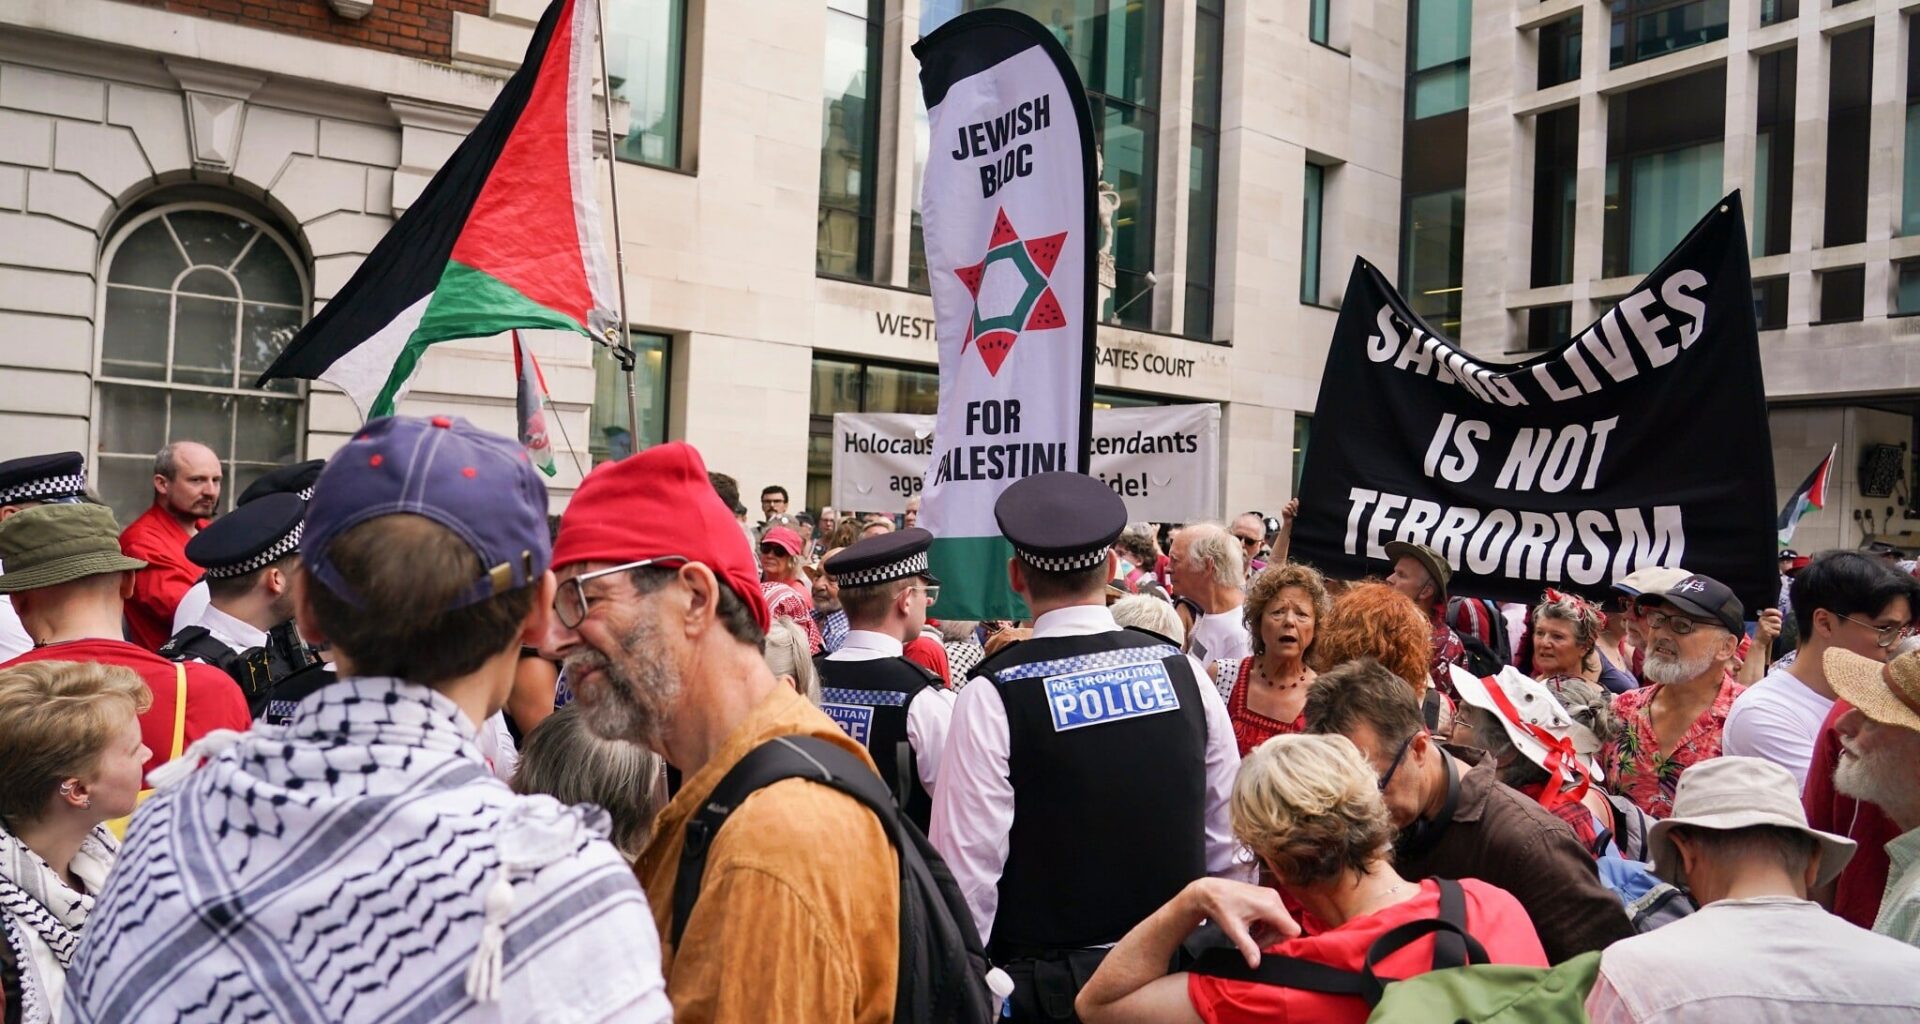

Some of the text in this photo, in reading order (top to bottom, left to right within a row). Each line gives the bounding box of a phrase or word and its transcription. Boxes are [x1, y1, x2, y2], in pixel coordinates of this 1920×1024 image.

[952, 94, 1050, 160] JEWISH
[979, 143, 1033, 199] BLOC
[876, 311, 938, 342] WEST
[1143, 353, 1195, 378] COURT
[1531, 269, 1708, 402] LIVES
[966, 399, 1021, 436] FOR
[1423, 412, 1619, 493] IS NOT
[889, 471, 927, 497] aga
[1344, 487, 1686, 586] TERRORISM
[1052, 664, 1163, 693] METROPOLITAN
[1055, 678, 1174, 725] POLICE
